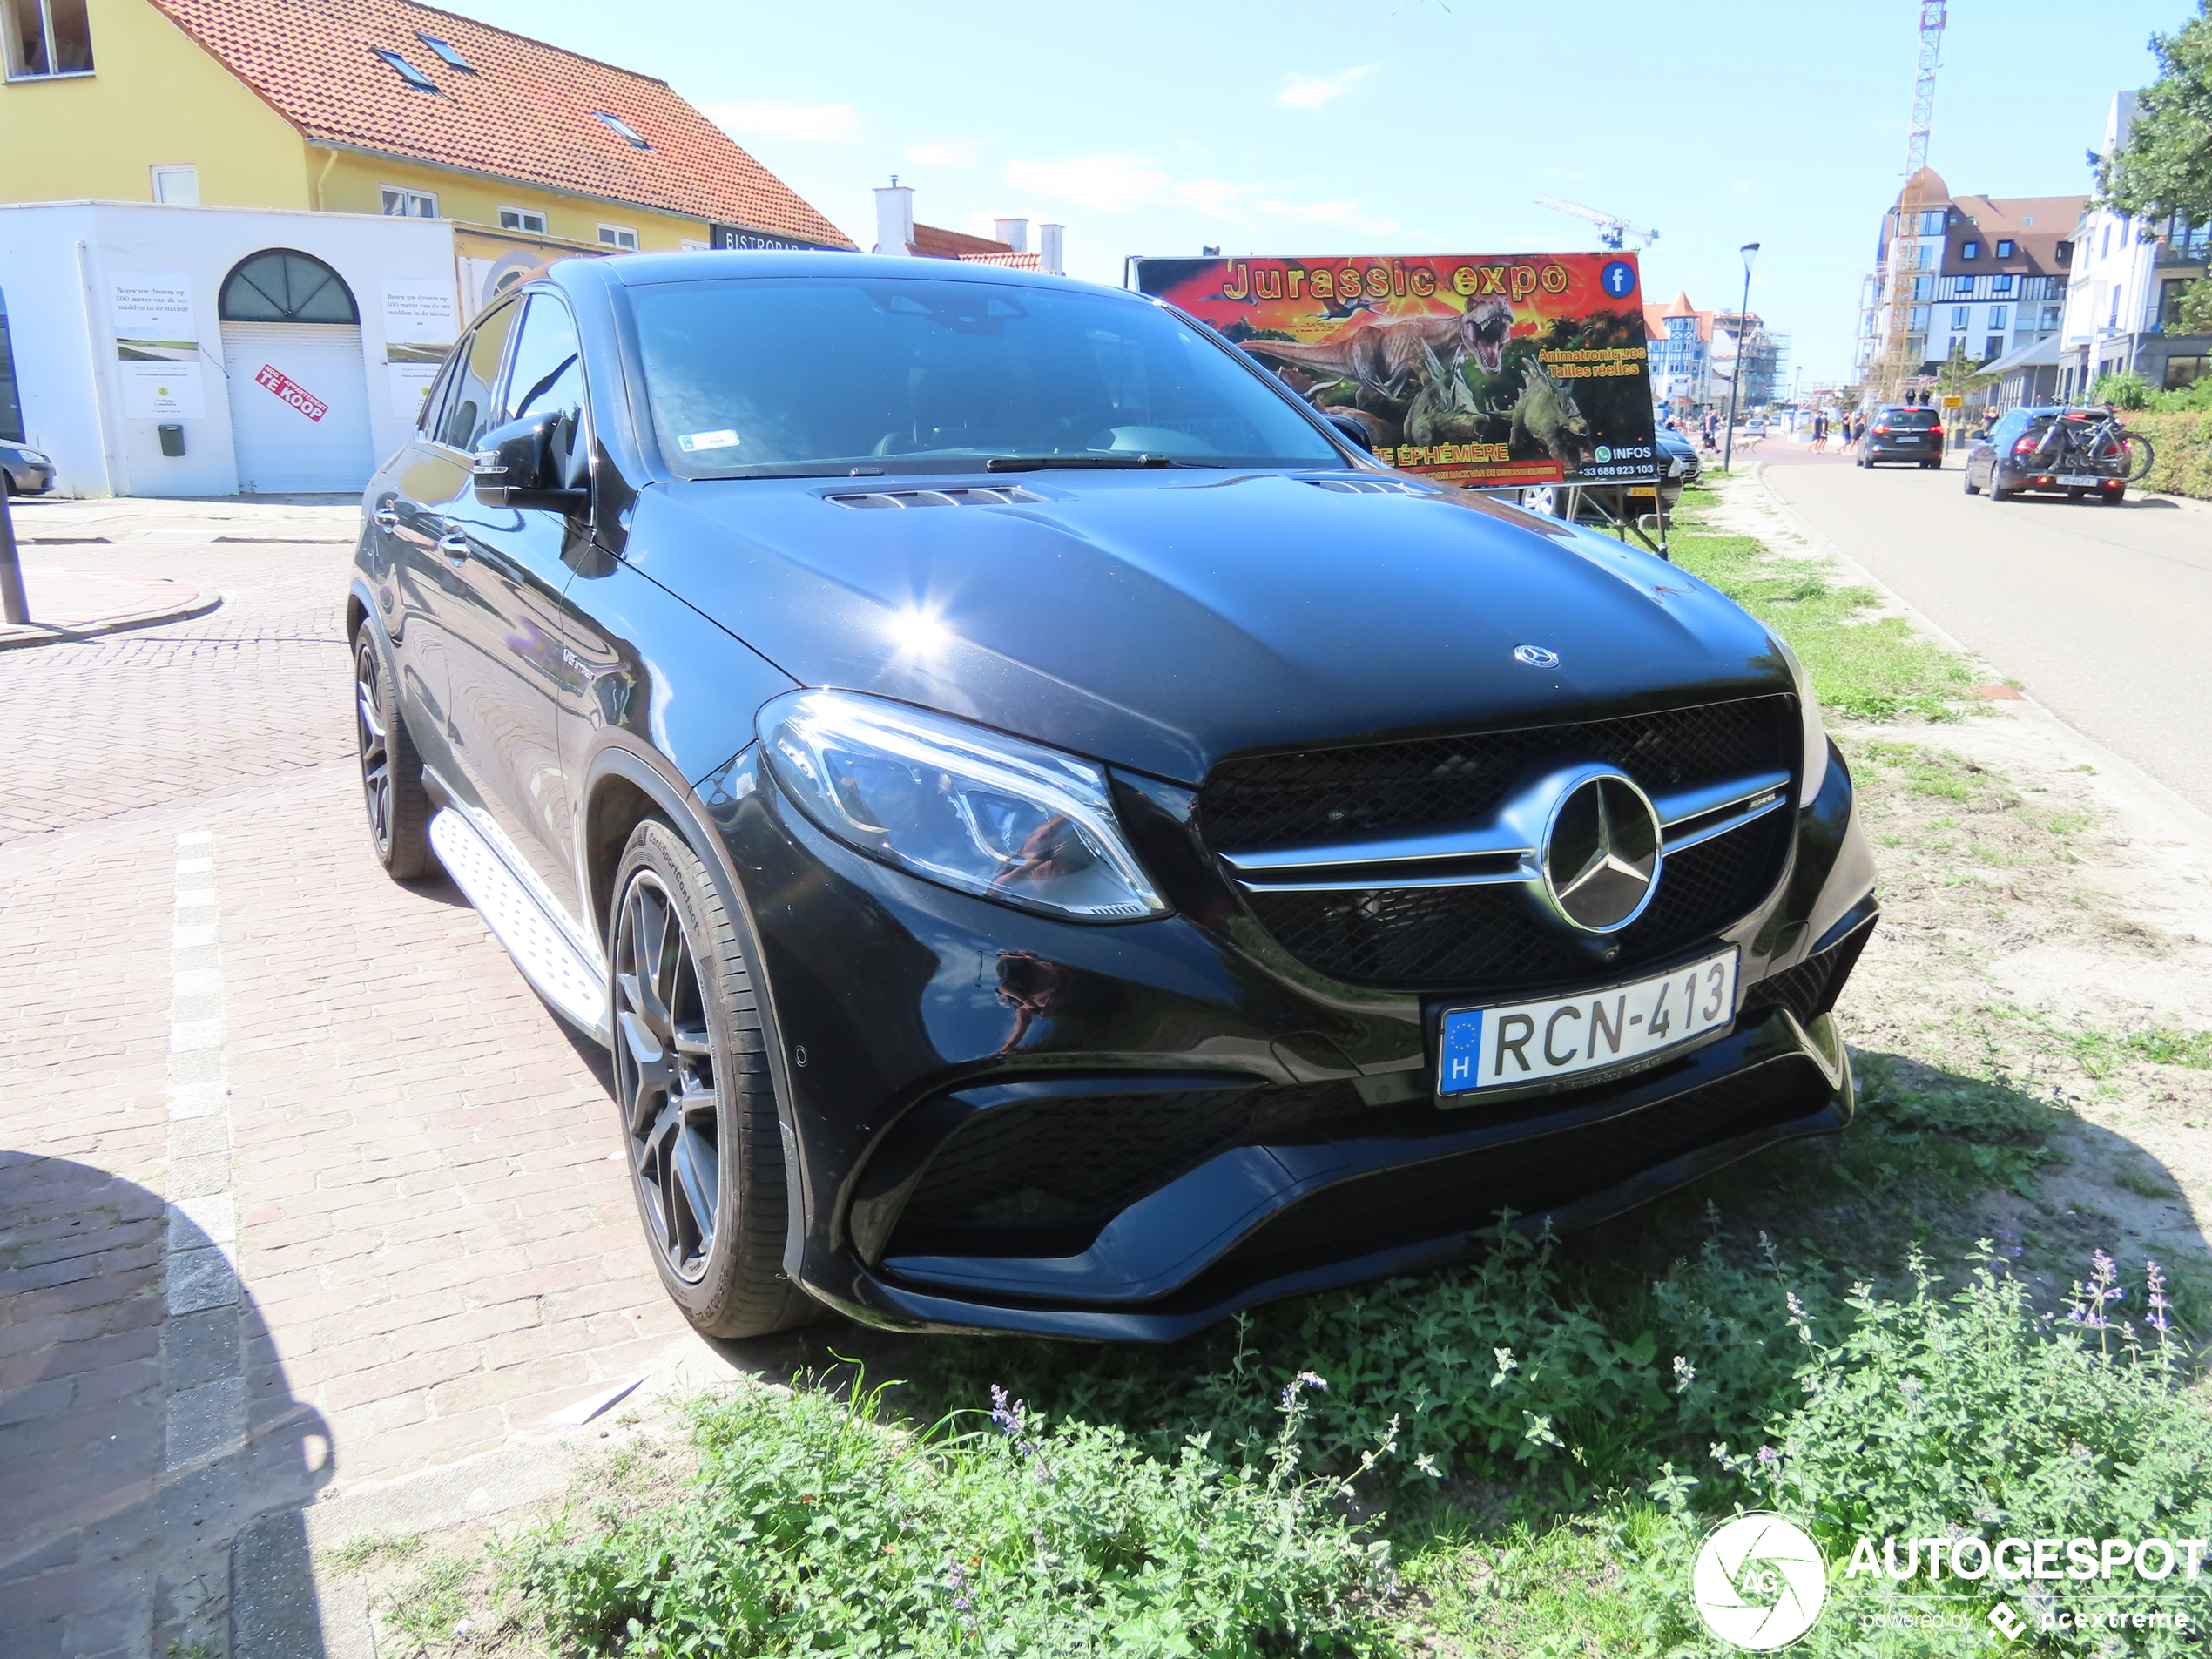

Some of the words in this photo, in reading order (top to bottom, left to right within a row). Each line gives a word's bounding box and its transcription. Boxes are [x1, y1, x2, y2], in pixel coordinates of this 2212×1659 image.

[1223, 260, 1436, 300] Jurassic
[1453, 265, 1568, 301] expo
[1539, 347, 1646, 363] Animatroniques
[1548, 364, 1592, 378] Tailles
[1593, 362, 1640, 377] réelles
[260, 370, 281, 391] TE
[280, 386, 323, 418] KOOP
[265, 366, 280, 378] NOG
[284, 380, 327, 411] APPARTEMENT
[1397, 442, 1509, 467] ÉPHÉMÈRE
[1613, 447, 1652, 460] INFOS
[1449, 470, 1469, 479] BACK
[1469, 469, 1486, 478] VAN
[1486, 469, 1496, 477] DE
[1578, 468, 1596, 476] +33
[1597, 467, 1615, 475] 688
[1616, 466, 1635, 475] 923
[1636, 464, 1654, 474] 103
[648, 833, 700, 932] ContiSportContact
[1494, 963, 1725, 1076] RCN-413
[1452, 1056, 1469, 1080] H
